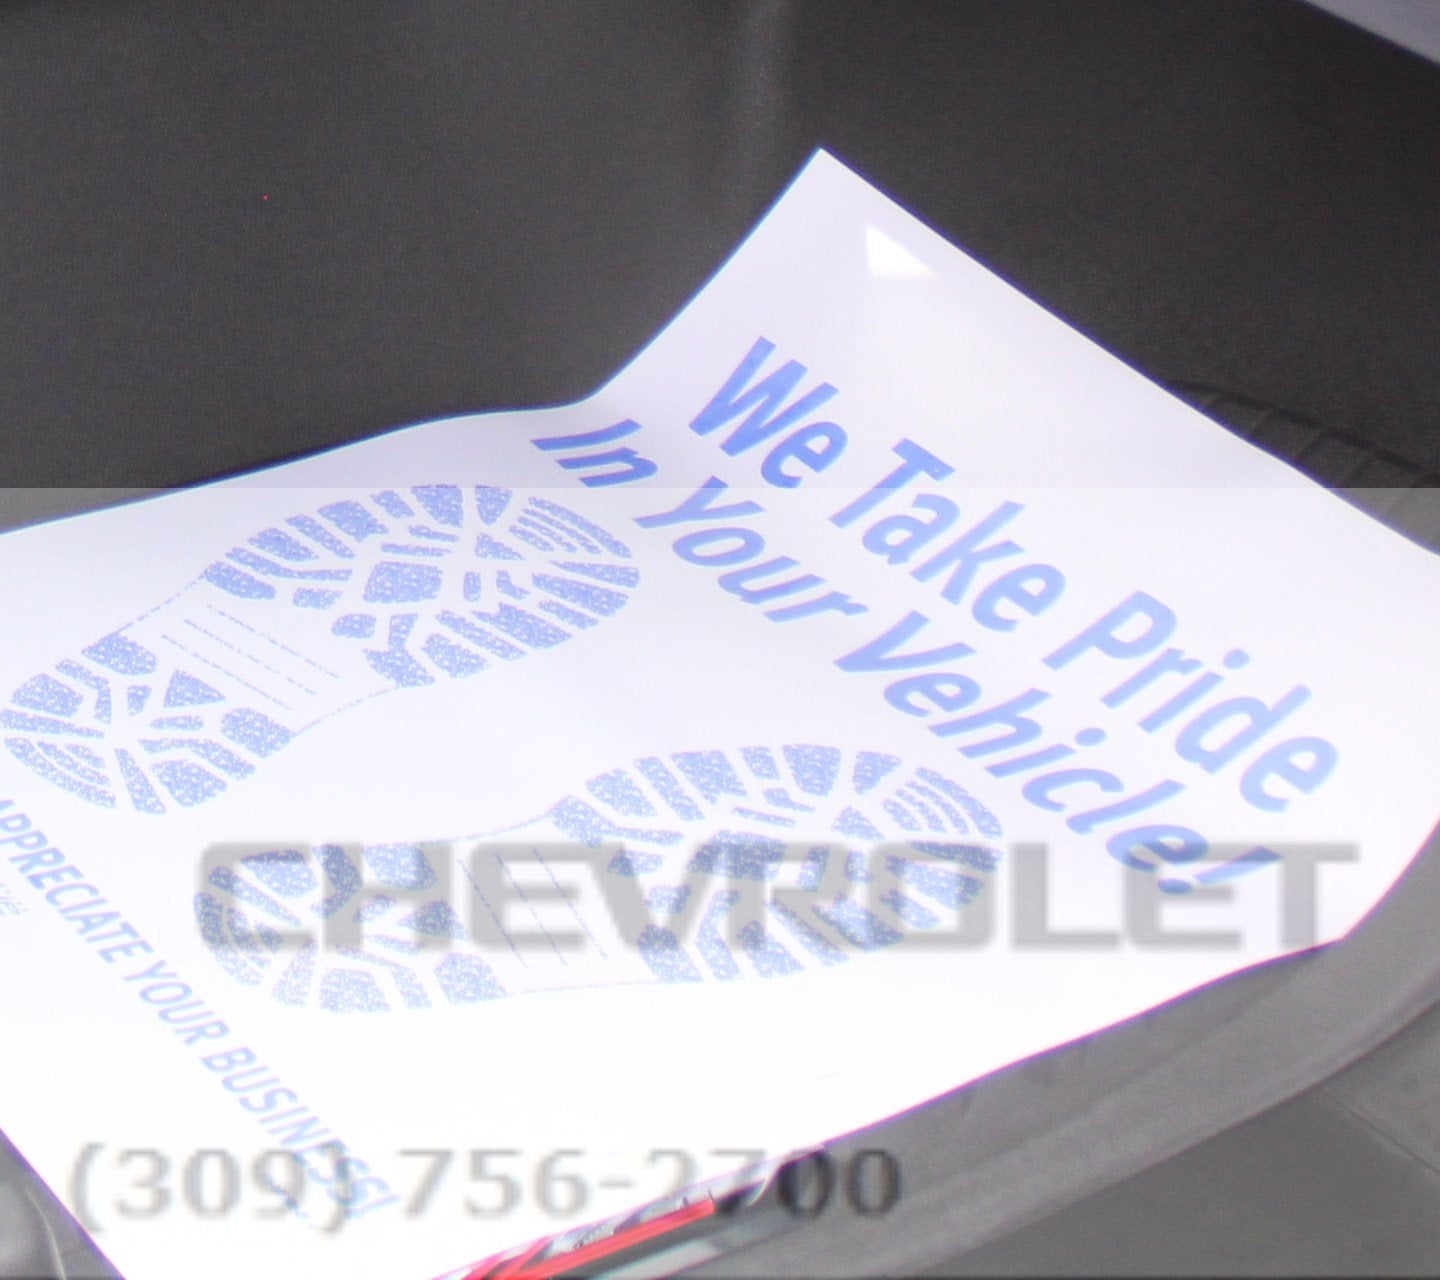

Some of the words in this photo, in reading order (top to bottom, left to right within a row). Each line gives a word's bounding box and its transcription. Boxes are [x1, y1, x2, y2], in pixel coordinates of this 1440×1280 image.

[530, 418, 659, 488] In
[633, 475, 870, 623] Your
[833, 610, 1281, 895] Vehicle!
[688, 336, 848, 488] We
[828, 438, 1066, 632] Take
[1042, 591, 1339, 813] Pride
[123, 959, 230, 1046] YOUR
